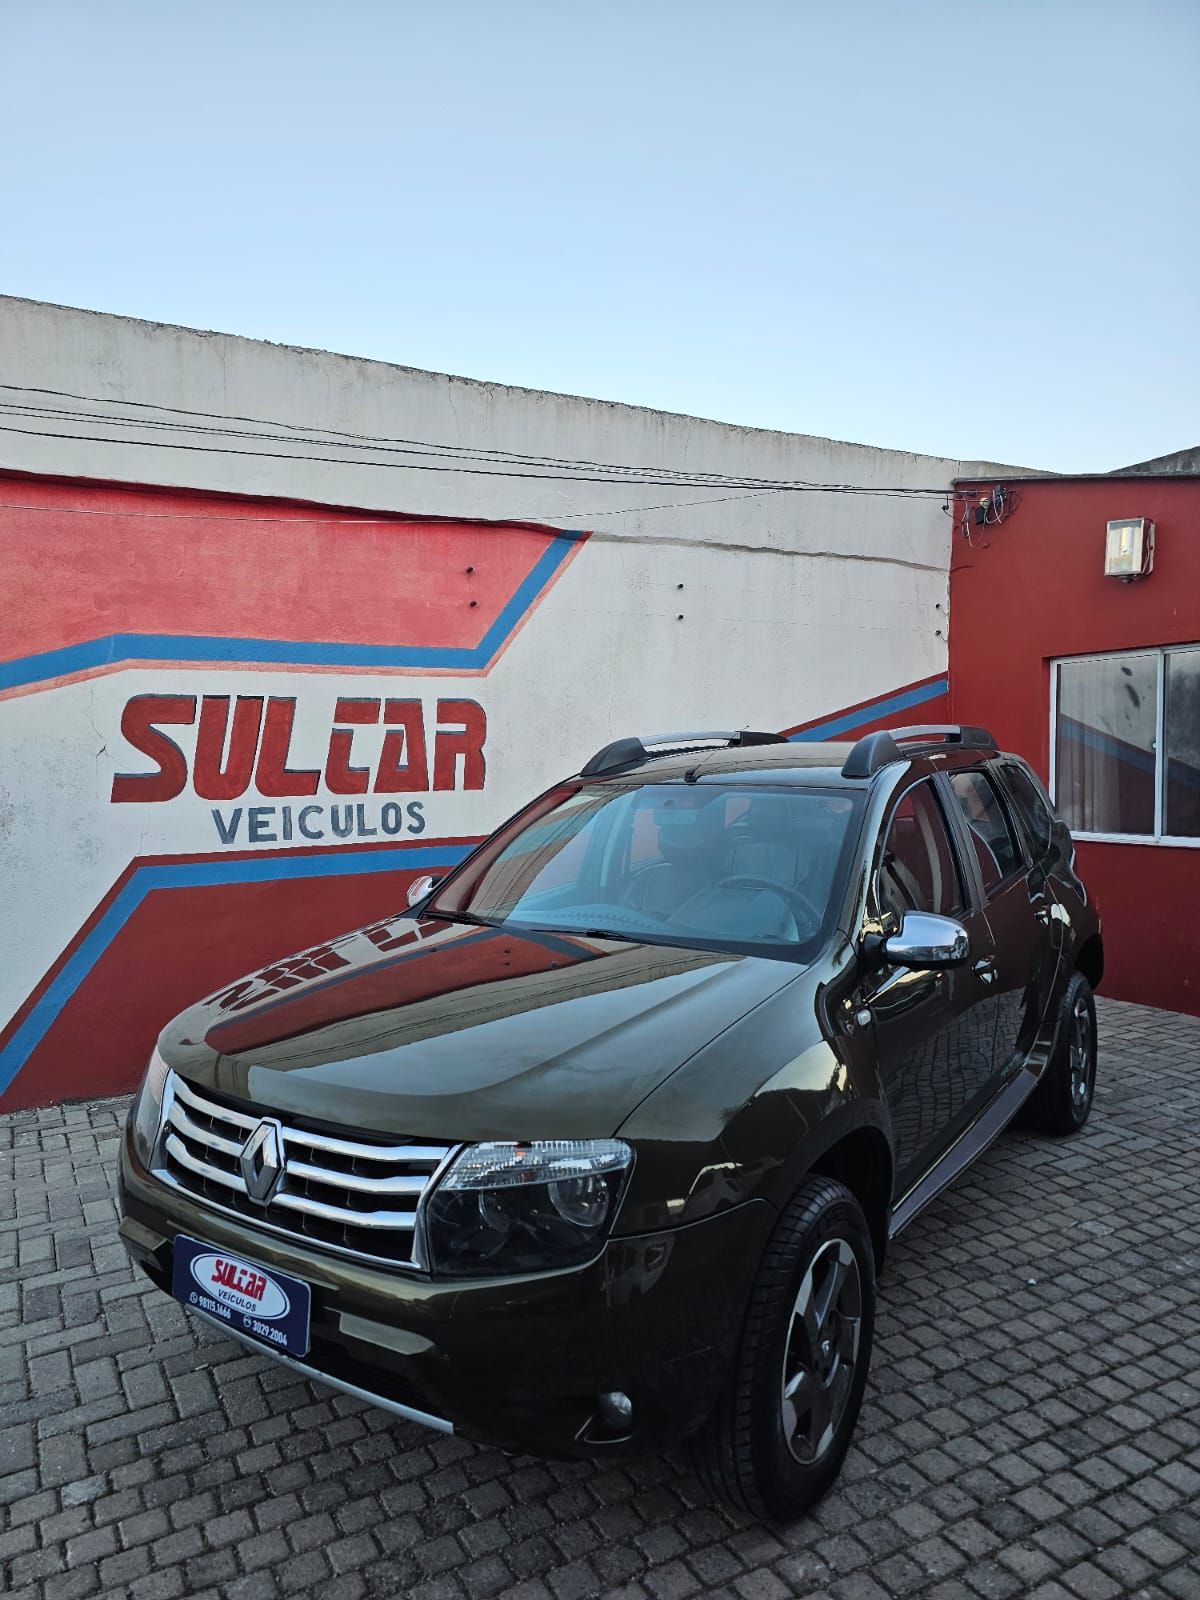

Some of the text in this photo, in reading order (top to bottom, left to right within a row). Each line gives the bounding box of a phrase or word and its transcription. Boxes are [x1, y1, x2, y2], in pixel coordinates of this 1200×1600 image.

[111, 694, 487, 803] SULCAR
[211, 801, 426, 844] VEICULOS
[211, 1259, 267, 1301] SULCAR
